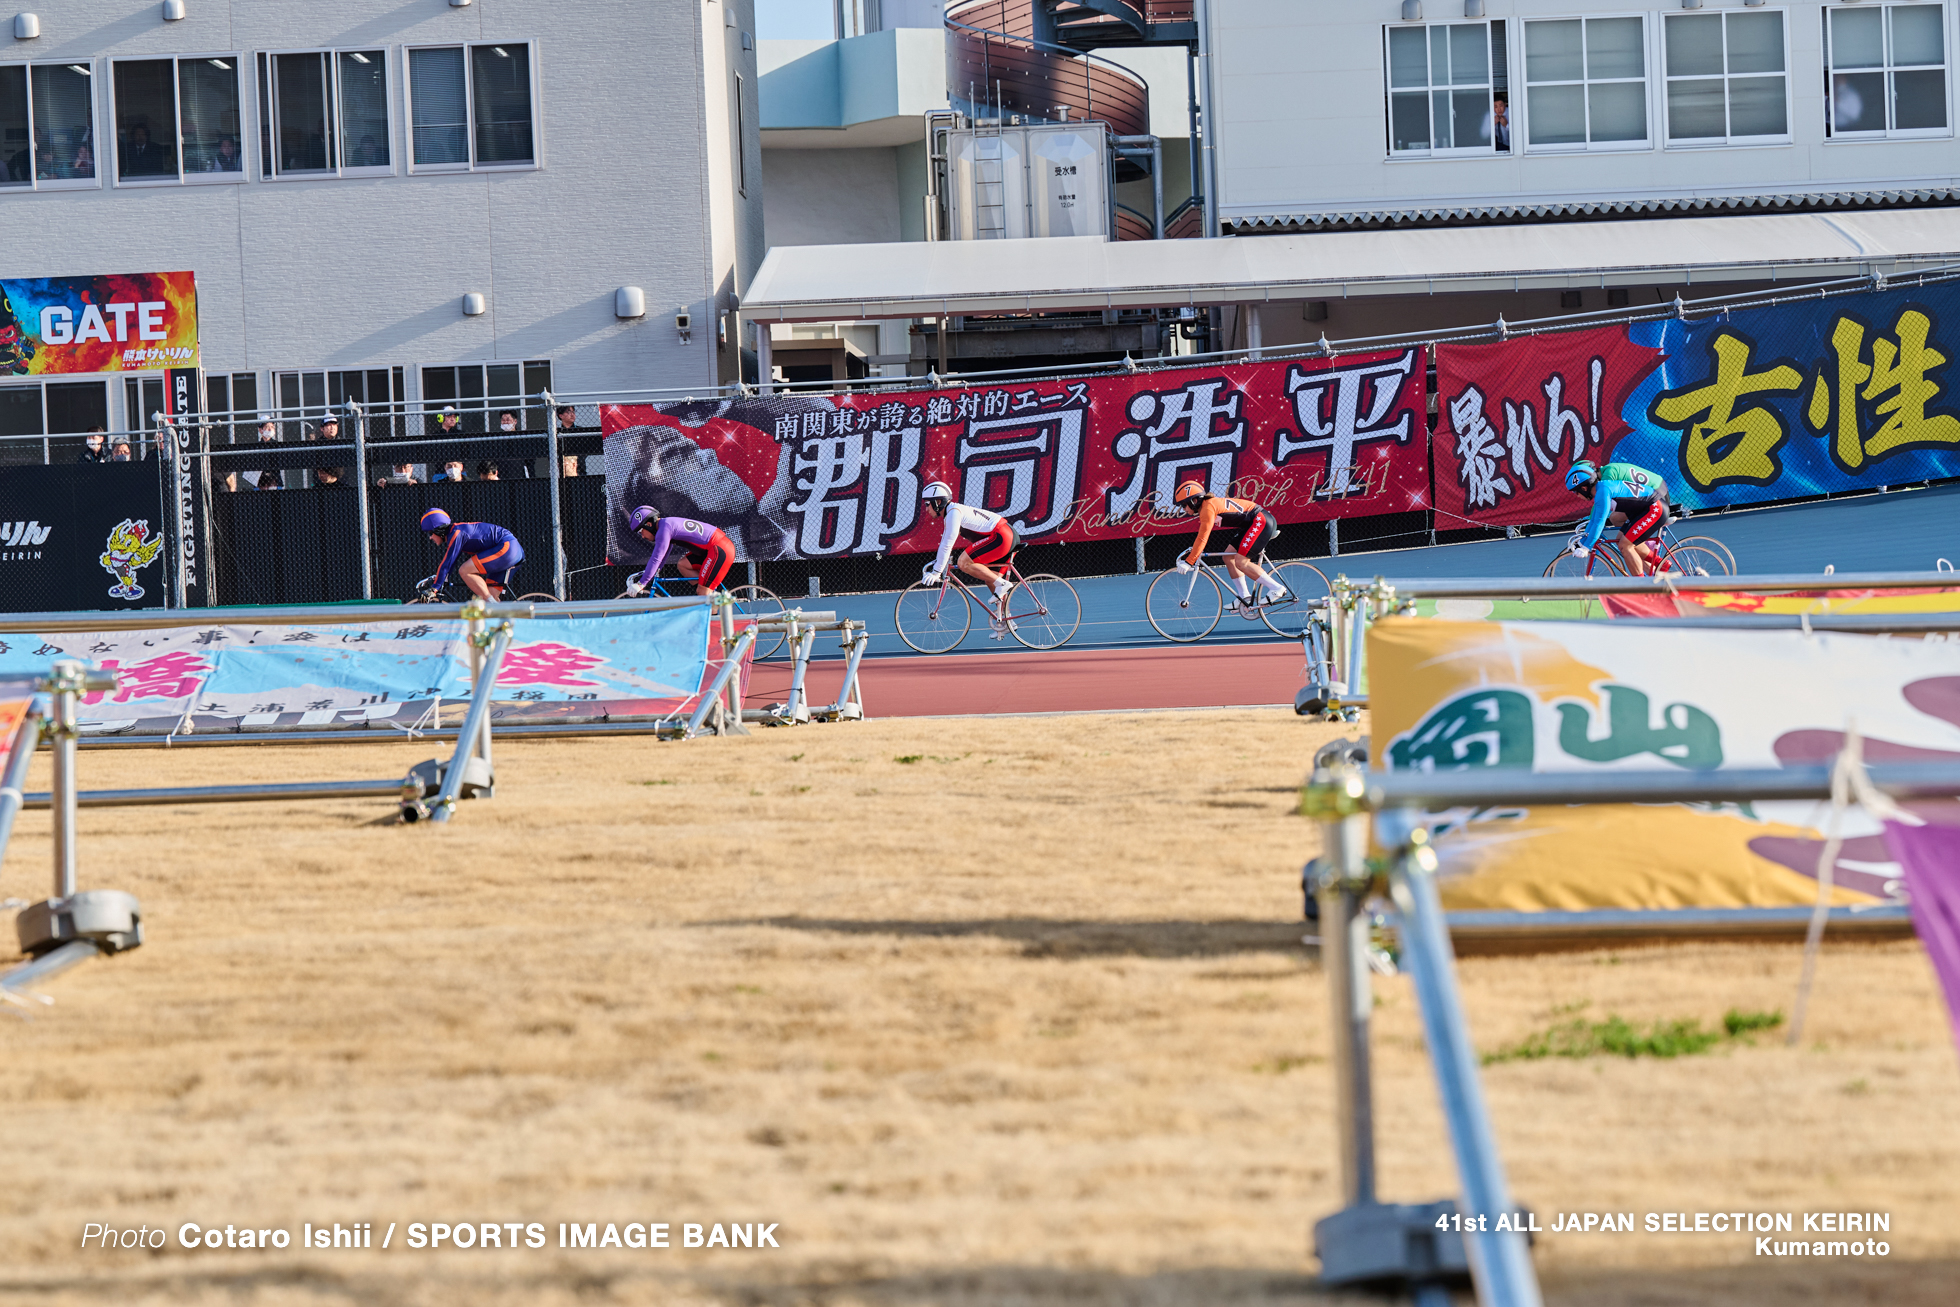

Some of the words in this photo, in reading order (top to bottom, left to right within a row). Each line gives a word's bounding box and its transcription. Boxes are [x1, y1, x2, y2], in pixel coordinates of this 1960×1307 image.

[1054, 166, 1077, 176] 受水槽
[40, 301, 168, 345] GATE
[176, 376, 190, 448] GATE
[774, 381, 1091, 442] 南関東が誇る絶対的エース
[1654, 309, 1960, 487] 古性
[786, 350, 1414, 556] 郡司浩平
[1571, 473, 1580, 486] 4
[180, 452, 197, 587] FIGHTING
[683, 518, 704, 537] 9
[1225, 498, 1245, 514] 7
[700, 557, 712, 578] KEIRIN
